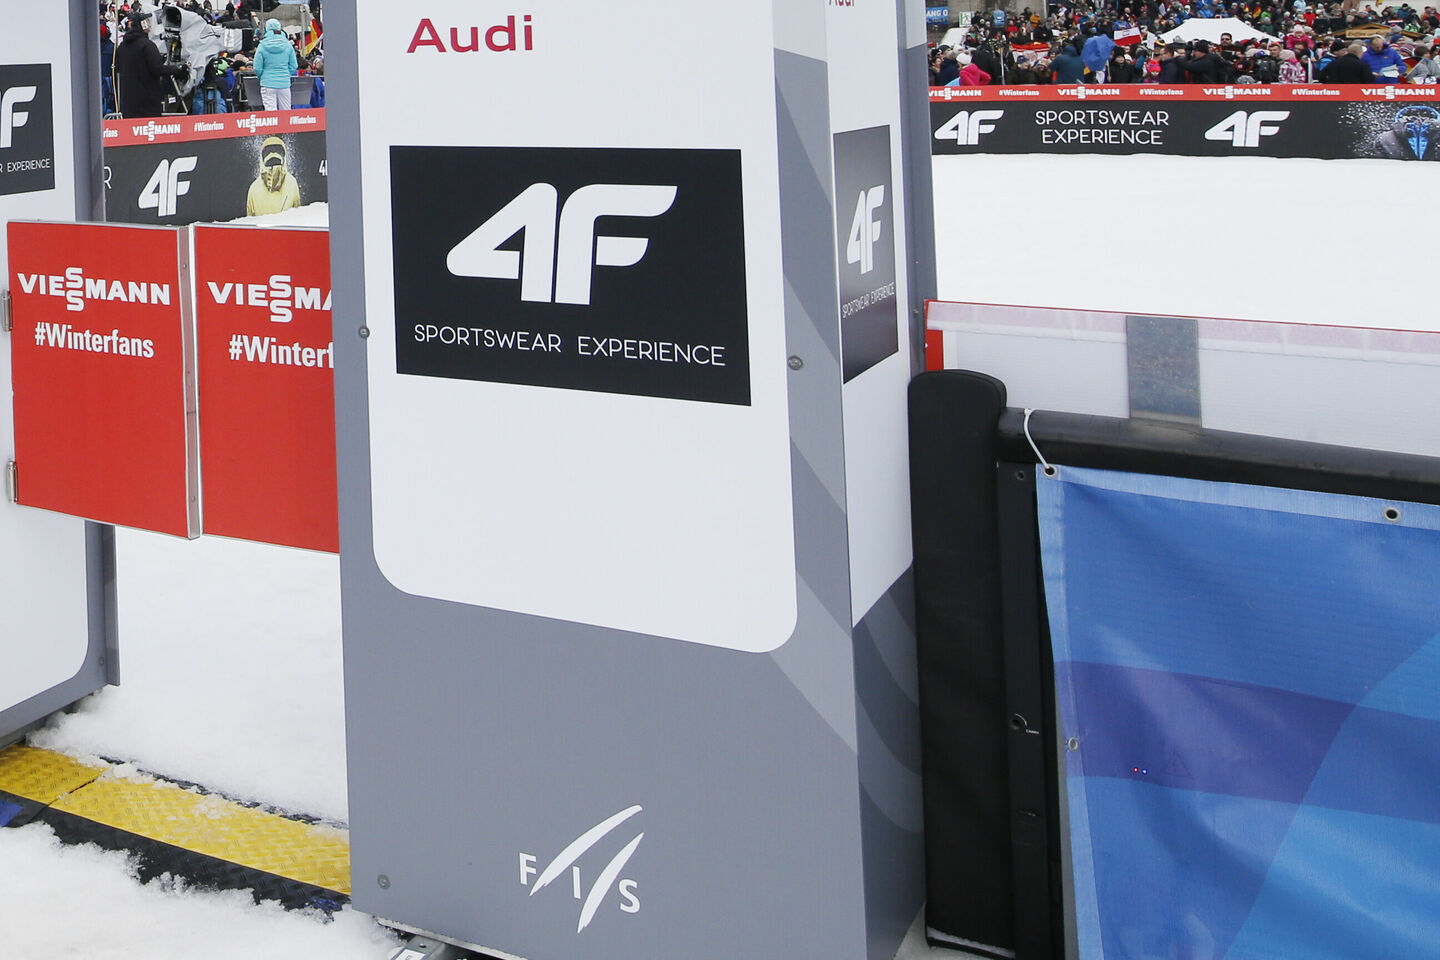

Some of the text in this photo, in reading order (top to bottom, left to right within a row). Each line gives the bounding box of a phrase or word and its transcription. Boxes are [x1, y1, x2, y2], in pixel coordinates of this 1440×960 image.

[406, 14, 534, 54] Audi
[998, 89, 1040, 97] #Winterfans
[1057, 86, 1120, 100] VIESSMANN
[1139, 88, 1184, 97] #Winterfans
[1203, 85, 1271, 100] VIESSMANN
[1291, 88, 1341, 97] #Winterfans
[1361, 85, 1436, 100] VIESSMANN
[132, 120, 181, 141] VIESSMANN
[236, 114, 279, 133] VIESSMANN
[934, 109, 1005, 146] 4F
[1034, 110, 1170, 126] SPORTSWEAR
[1204, 110, 1291, 148] 4F
[1041, 129, 1164, 145] EXPERIENCE
[7, 158, 51, 173] EXPERIENCE
[138, 156, 198, 217] 4F
[446, 181, 678, 305] 4F
[846, 184, 885, 275] 4F
[17, 267, 171, 312] VIESSMANN
[207, 275, 332, 323] VIESSM
[34, 322, 155, 359] #Winterfans
[229, 334, 334, 369] #Winterf
[413, 324, 726, 366] SPORTSWEAR EXPERIENCE
